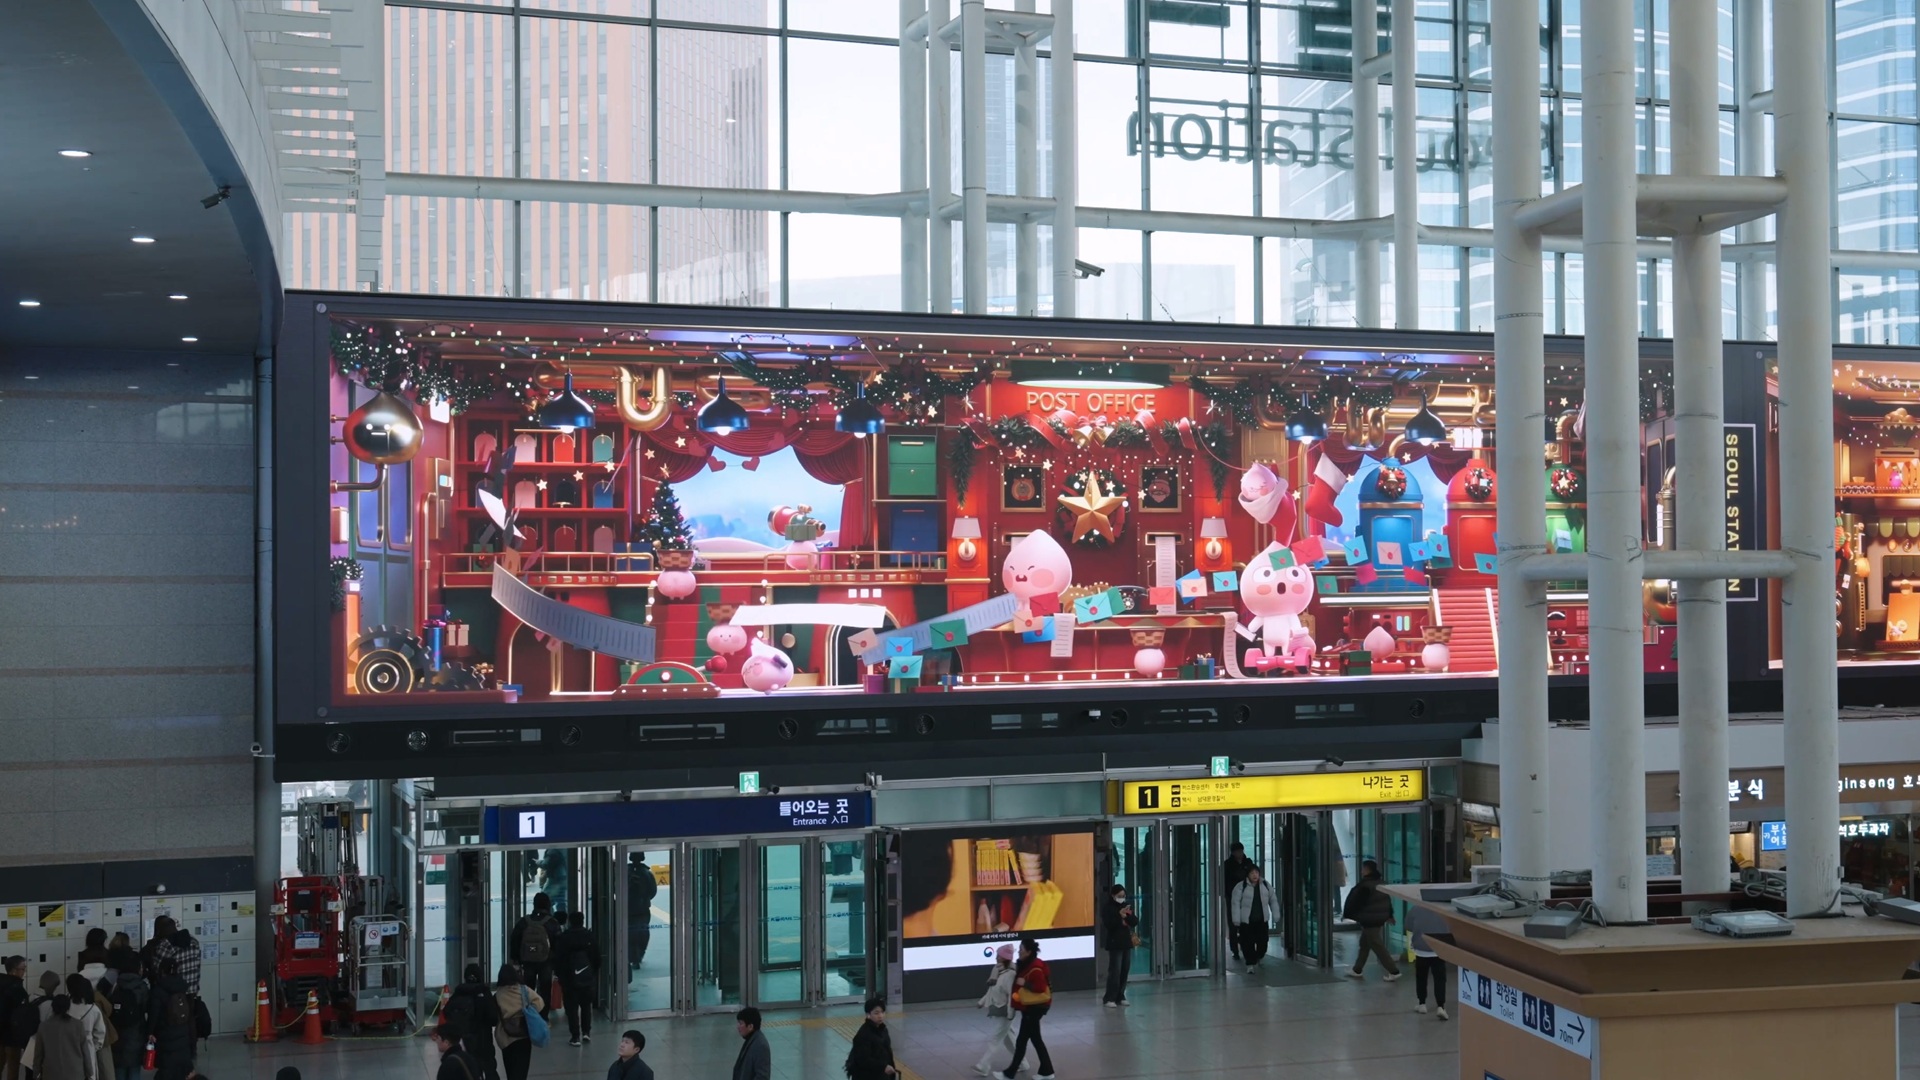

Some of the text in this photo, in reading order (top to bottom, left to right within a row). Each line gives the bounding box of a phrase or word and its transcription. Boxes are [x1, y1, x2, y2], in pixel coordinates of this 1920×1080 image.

[1026, 391, 1156, 413] POST OFFICE
[1725, 433, 1741, 592] SEOUL STATN
[1363, 774, 1410, 789] 나가는 곳
[1903, 774, 1920, 788] 호
[1144, 788, 1152, 806] 1
[779, 798, 848, 816] 들어오는 곳
[527, 815, 535, 834] 1
[792, 815, 849, 826] Entrance 入口
[1462, 990, 1472, 1001] 30m
[1496, 982, 1518, 1007] 화장실
[1499, 1004, 1515, 1021] Toilet
[1559, 1029, 1574, 1045] 70m
